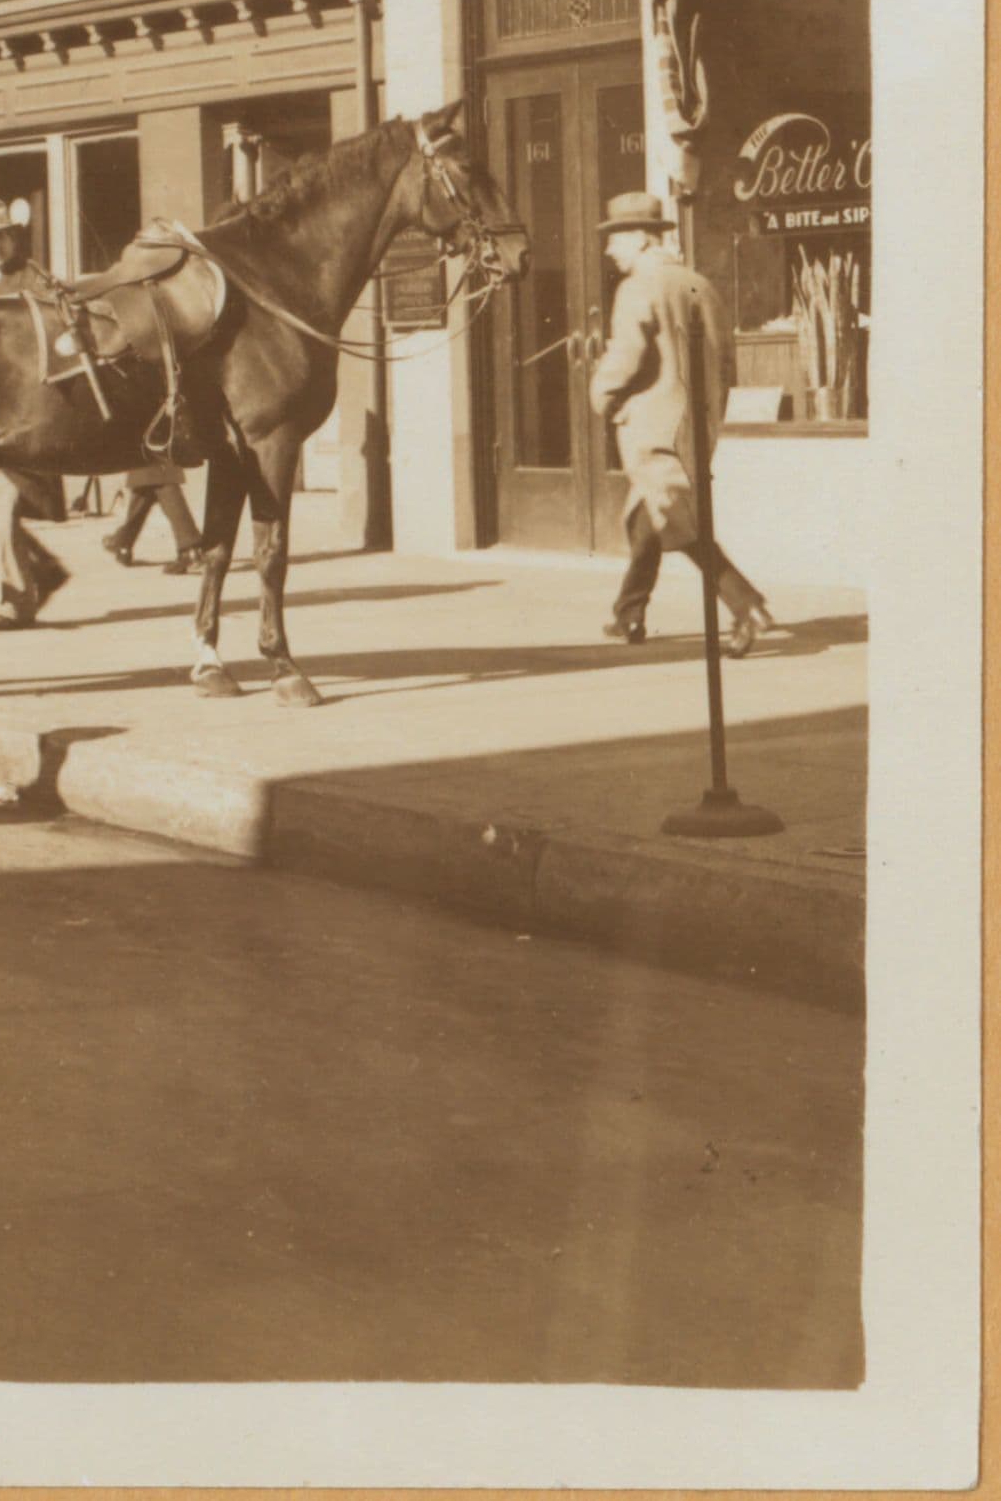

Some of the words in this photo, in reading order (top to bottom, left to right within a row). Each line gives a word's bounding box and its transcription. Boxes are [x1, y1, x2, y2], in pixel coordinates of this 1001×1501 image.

[527, 142, 550, 162] 161
[734, 141, 847, 201] Better
[784, 210, 821, 228] BITE
[842, 206, 870, 224] SIP
